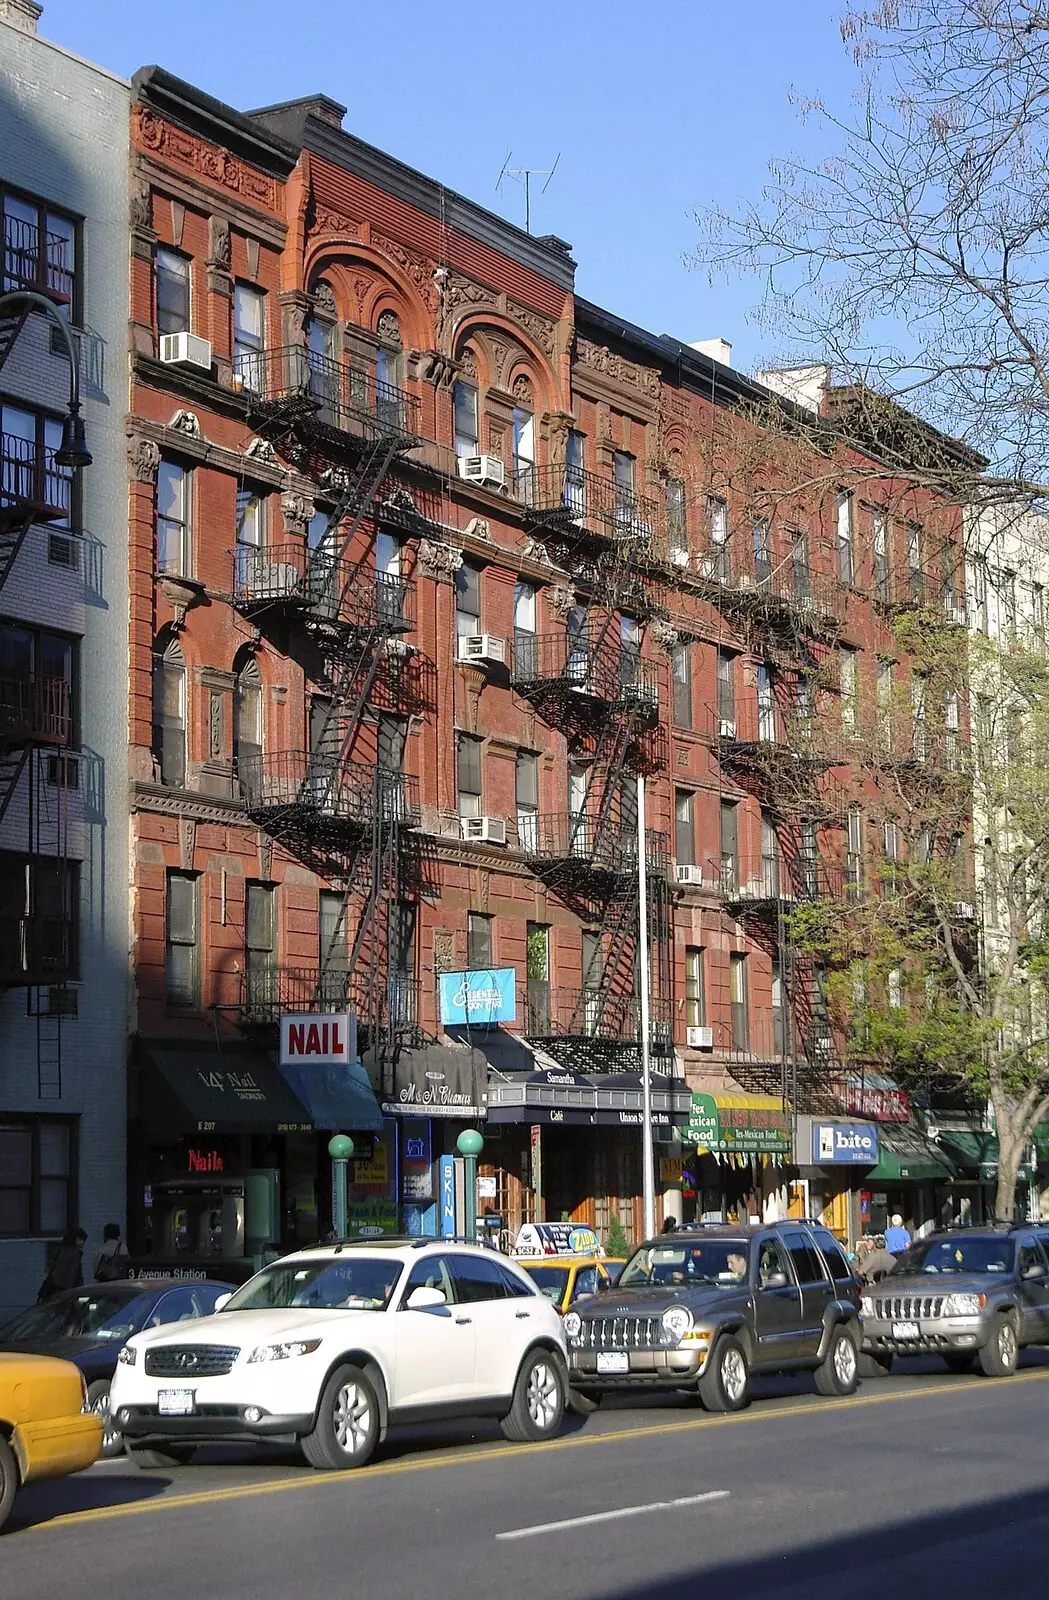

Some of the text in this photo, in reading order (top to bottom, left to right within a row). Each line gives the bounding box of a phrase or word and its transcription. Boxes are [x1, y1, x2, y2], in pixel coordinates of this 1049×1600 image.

[288, 1023, 344, 1055] NAIL
[226, 1072, 256, 1087] Nail
[546, 1072, 575, 1085] Samantha
[439, 1085, 471, 1106] Cleaners
[619, 1112, 638, 1123] Union
[659, 1113, 669, 1123] Inn
[688, 1129, 713, 1141] Food
[765, 1130, 777, 1140] Food
[836, 1130, 872, 1149] bite
[188, 1149, 224, 1172] Nails
[444, 1165, 453, 1217] SKIN
[128, 1268, 207, 1279] 3 Avenue Station
